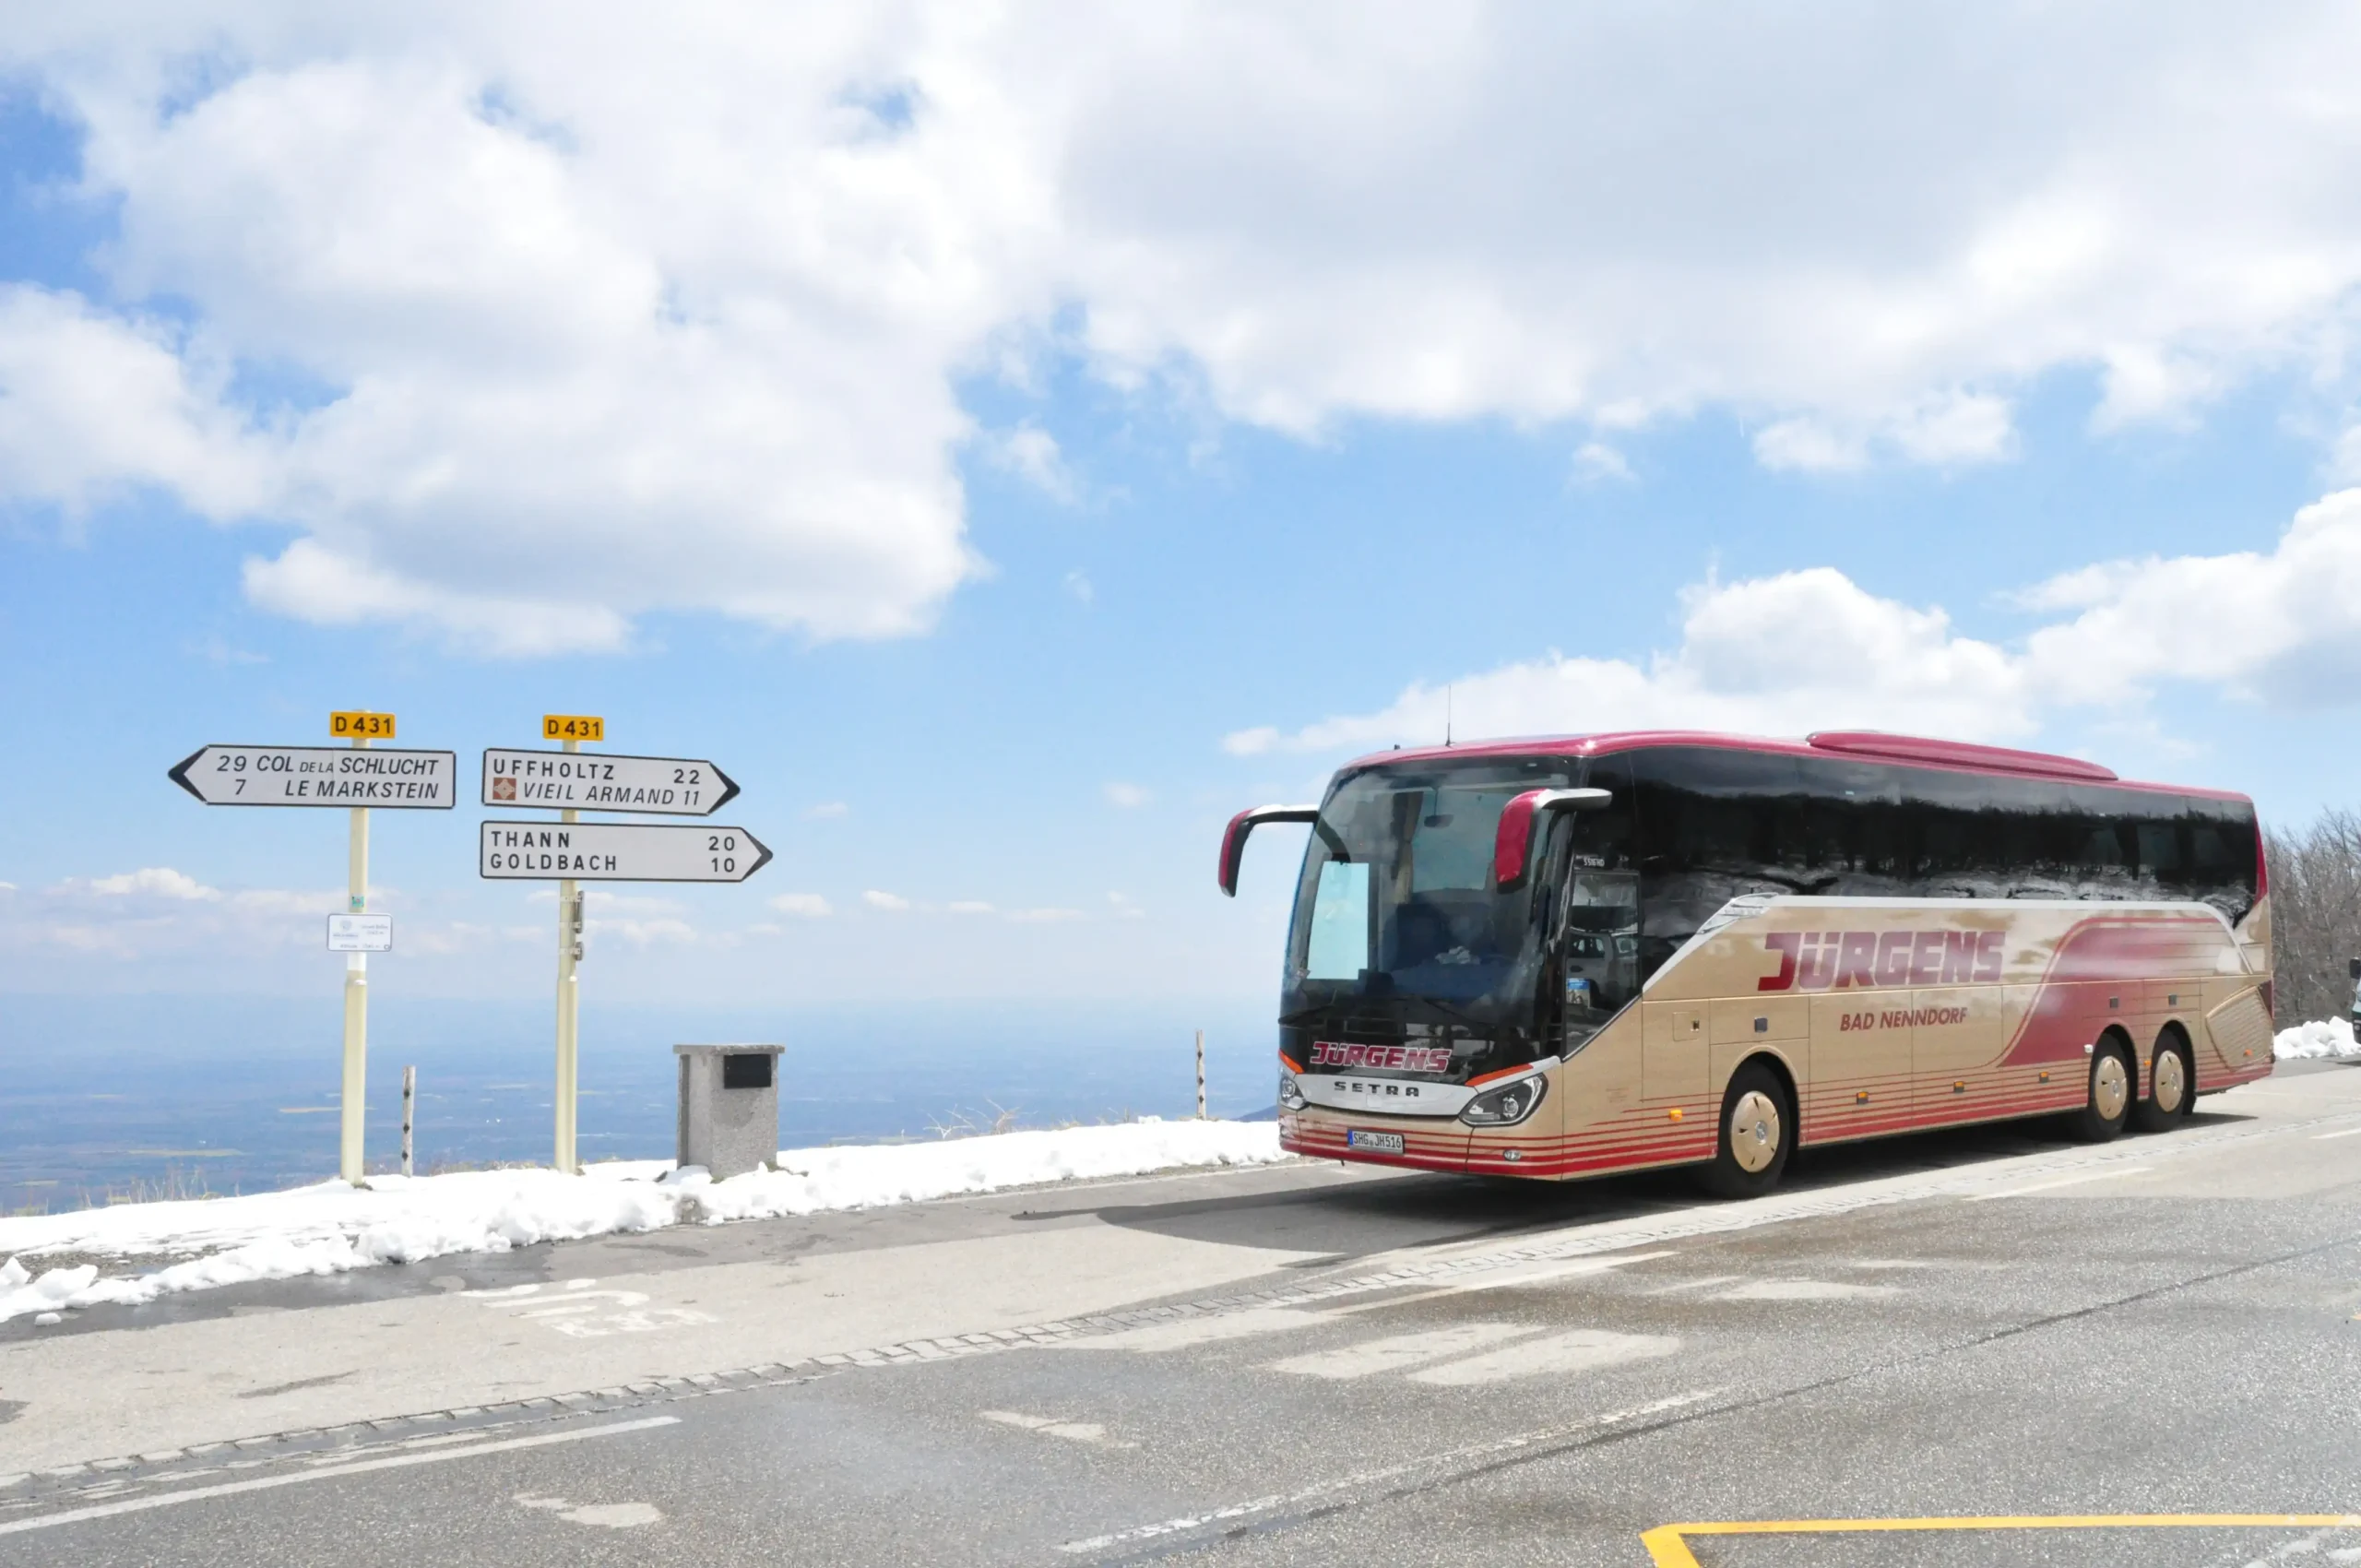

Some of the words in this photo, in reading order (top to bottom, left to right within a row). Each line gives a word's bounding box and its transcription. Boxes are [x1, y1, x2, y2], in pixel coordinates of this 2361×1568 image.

[335, 717, 347, 732] D
[352, 718, 391, 733] 431
[548, 719, 559, 735] D
[564, 720, 600, 737] 431
[217, 755, 247, 772] 29
[256, 755, 294, 773] COL
[299, 762, 317, 773] DE
[318, 762, 334, 773] LA
[339, 757, 439, 776] SCHLUCHT
[493, 758, 614, 780] UFFHOLTZ
[673, 769, 700, 785] 22
[234, 779, 246, 795] 7
[285, 780, 309, 797] LE
[316, 780, 439, 799] MARKSTEIN
[524, 782, 575, 801] VIEIL
[586, 785, 674, 805] ARMAND
[683, 790, 700, 806] 11
[491, 831, 570, 848] THANN
[708, 836, 735, 851] 20
[491, 853, 617, 872] GOLDBACH
[711, 858, 735, 873] 10
[1758, 931, 2006, 992] JÜRGENS
[1840, 1011, 1875, 1031] BAD
[1880, 1007, 1968, 1029] NENNDORF
[1310, 1041, 1453, 1074] JÜRGENS
[1334, 1081, 1419, 1098] SETRA
